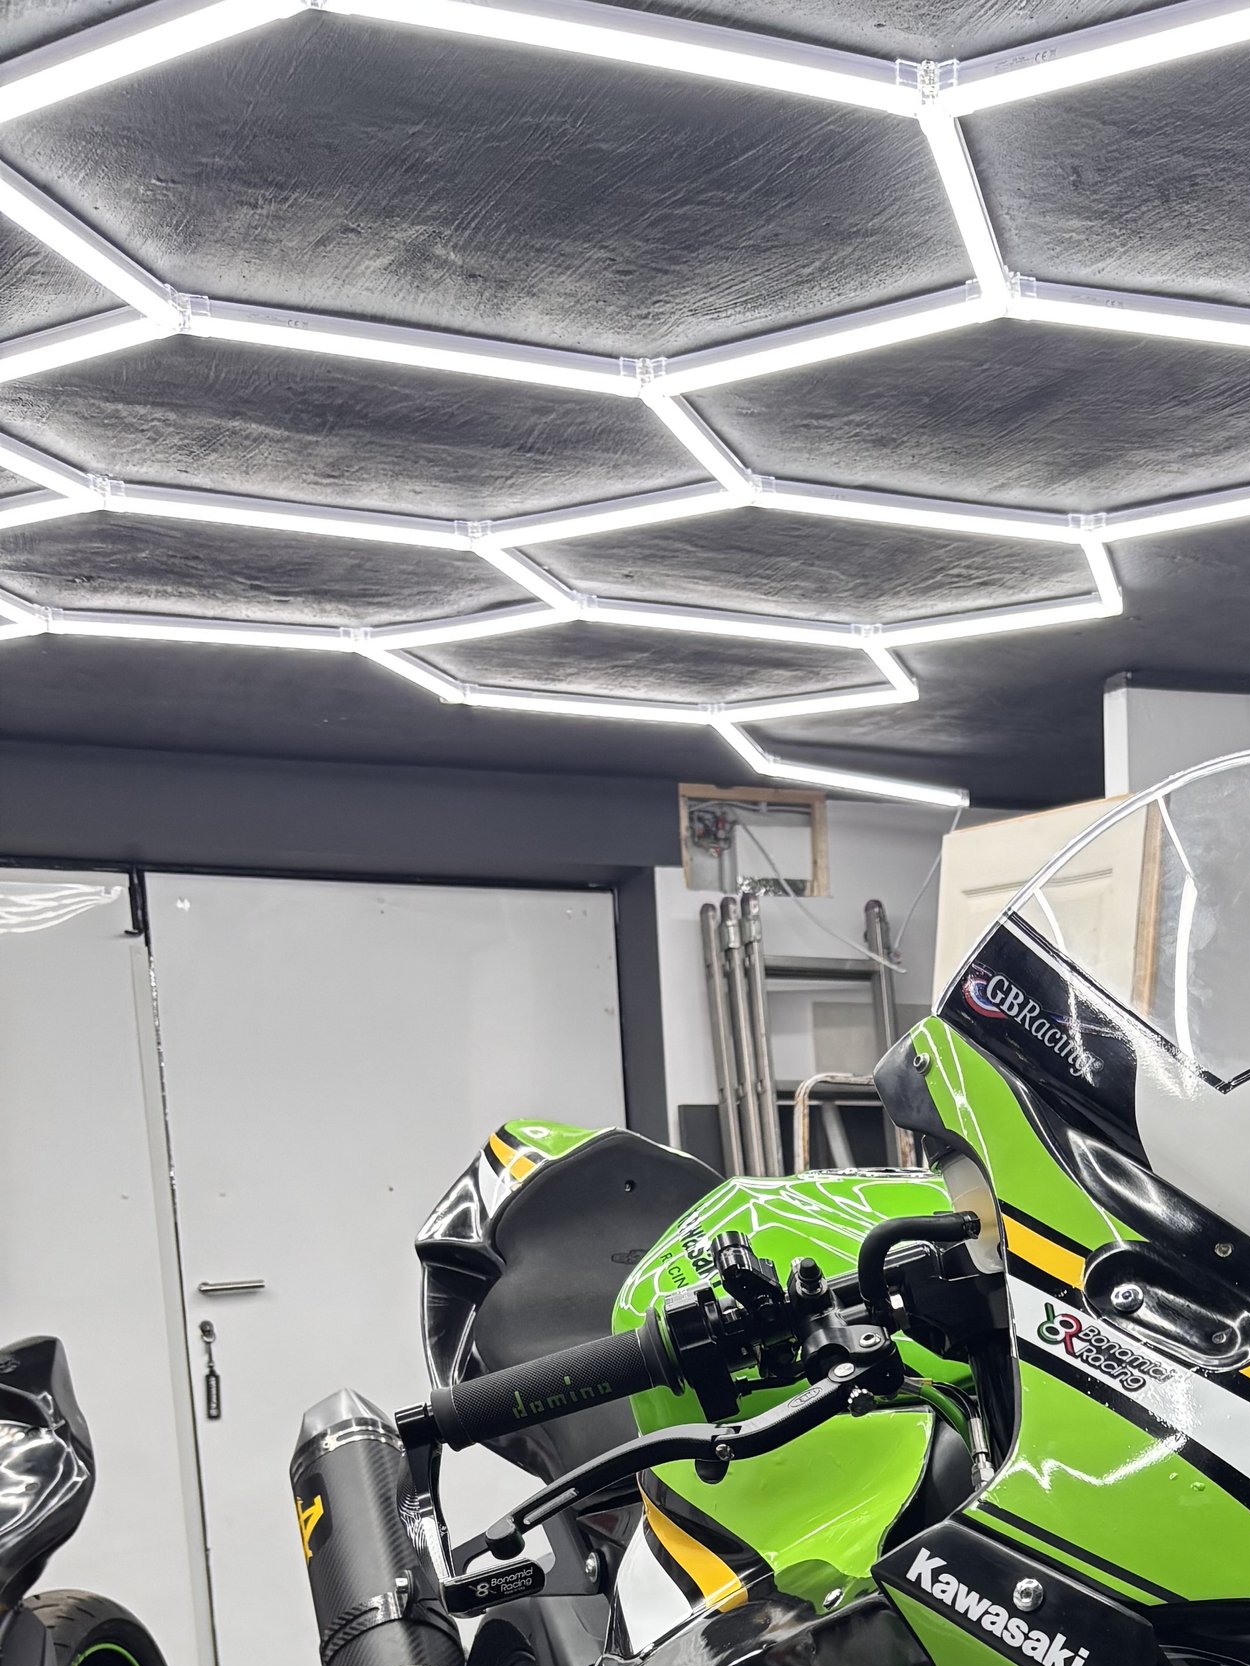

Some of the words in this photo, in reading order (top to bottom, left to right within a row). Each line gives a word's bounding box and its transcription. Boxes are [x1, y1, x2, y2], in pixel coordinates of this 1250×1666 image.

[986, 975, 1097, 1077] GBRacing
[1076, 1344, 1146, 1392] Racing
[1077, 1325, 1177, 1384] Bonamici
[512, 1376, 613, 1419] domino
[500, 1577, 533, 1592] Racing
